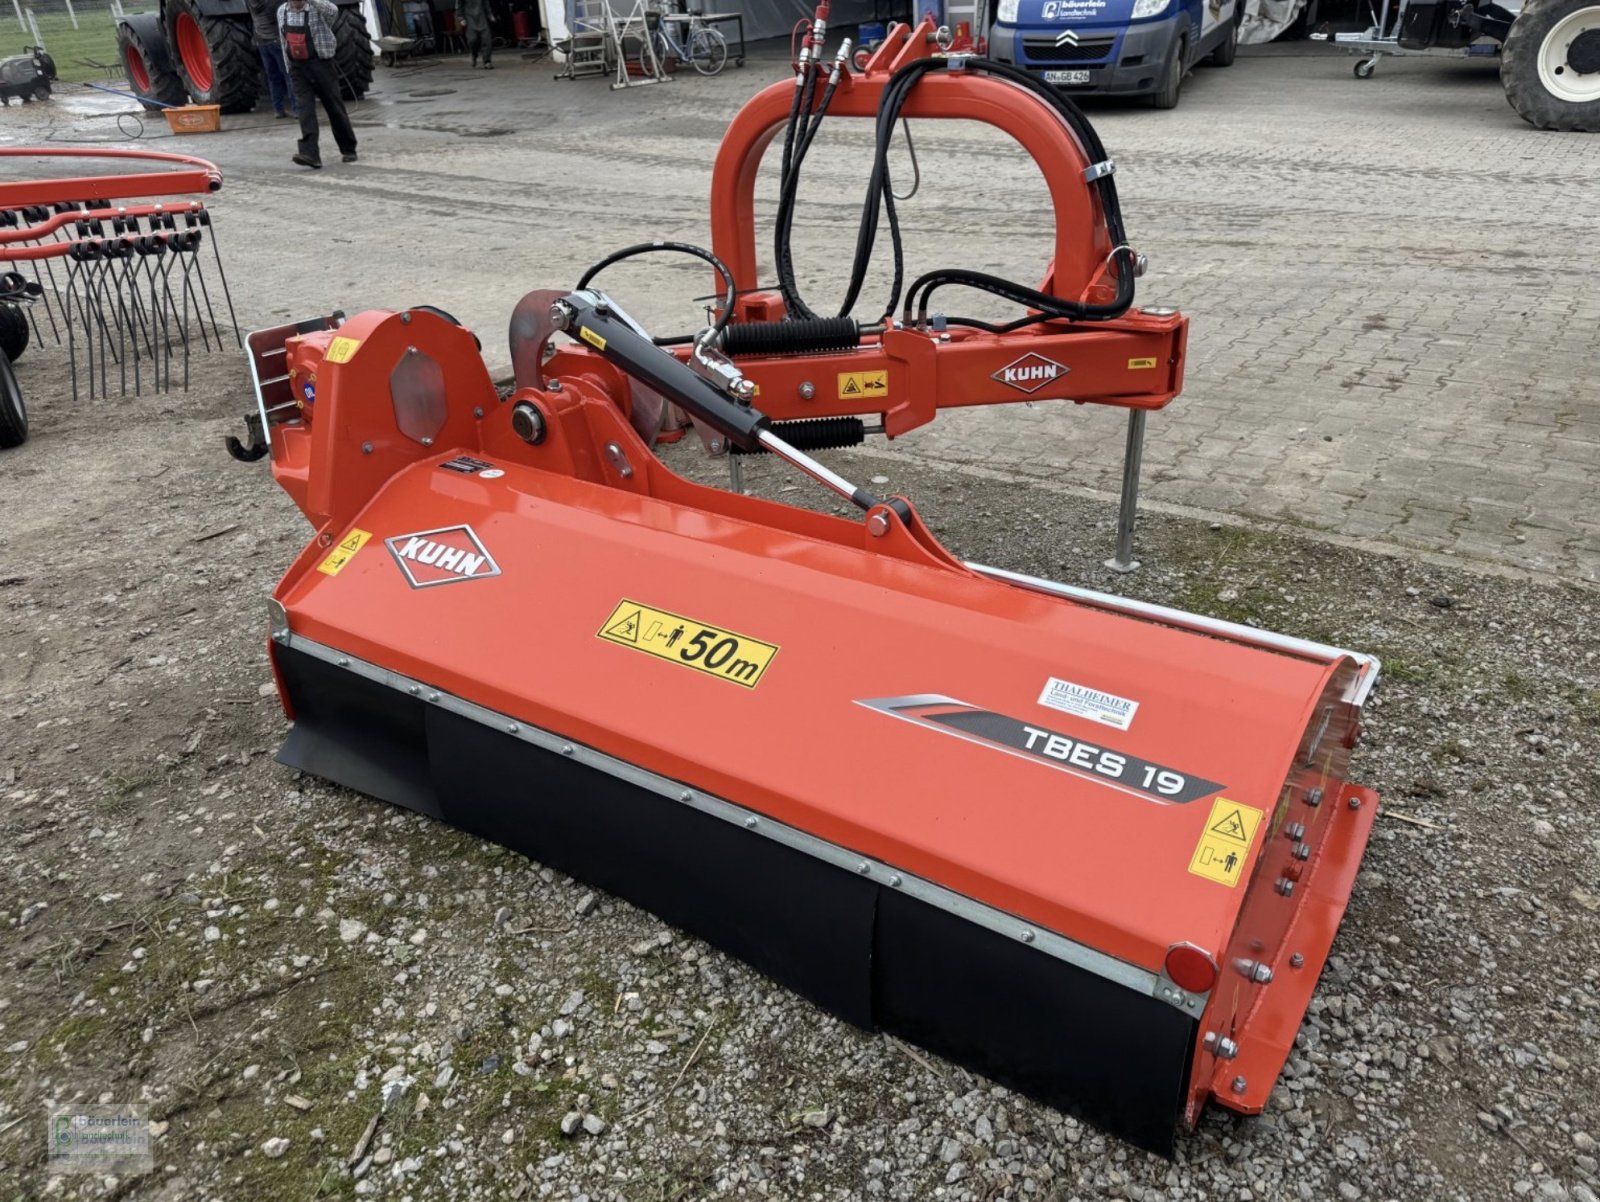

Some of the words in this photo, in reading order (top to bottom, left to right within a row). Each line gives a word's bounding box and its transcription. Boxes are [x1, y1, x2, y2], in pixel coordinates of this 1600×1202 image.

[1045, 72, 1056, 81] AN
[1061, 72, 1072, 81] GB
[1073, 72, 1089, 81] 426
[1004, 364, 1057, 382] KUHN
[398, 536, 487, 576] KUHN
[1054, 681, 1131, 710] THALHEIMER
[1070, 695, 1083, 704] und
[1084, 699, 1126, 717] Forsttechnik
[1022, 726, 1127, 778] TBES
[1142, 765, 1186, 795] 19
